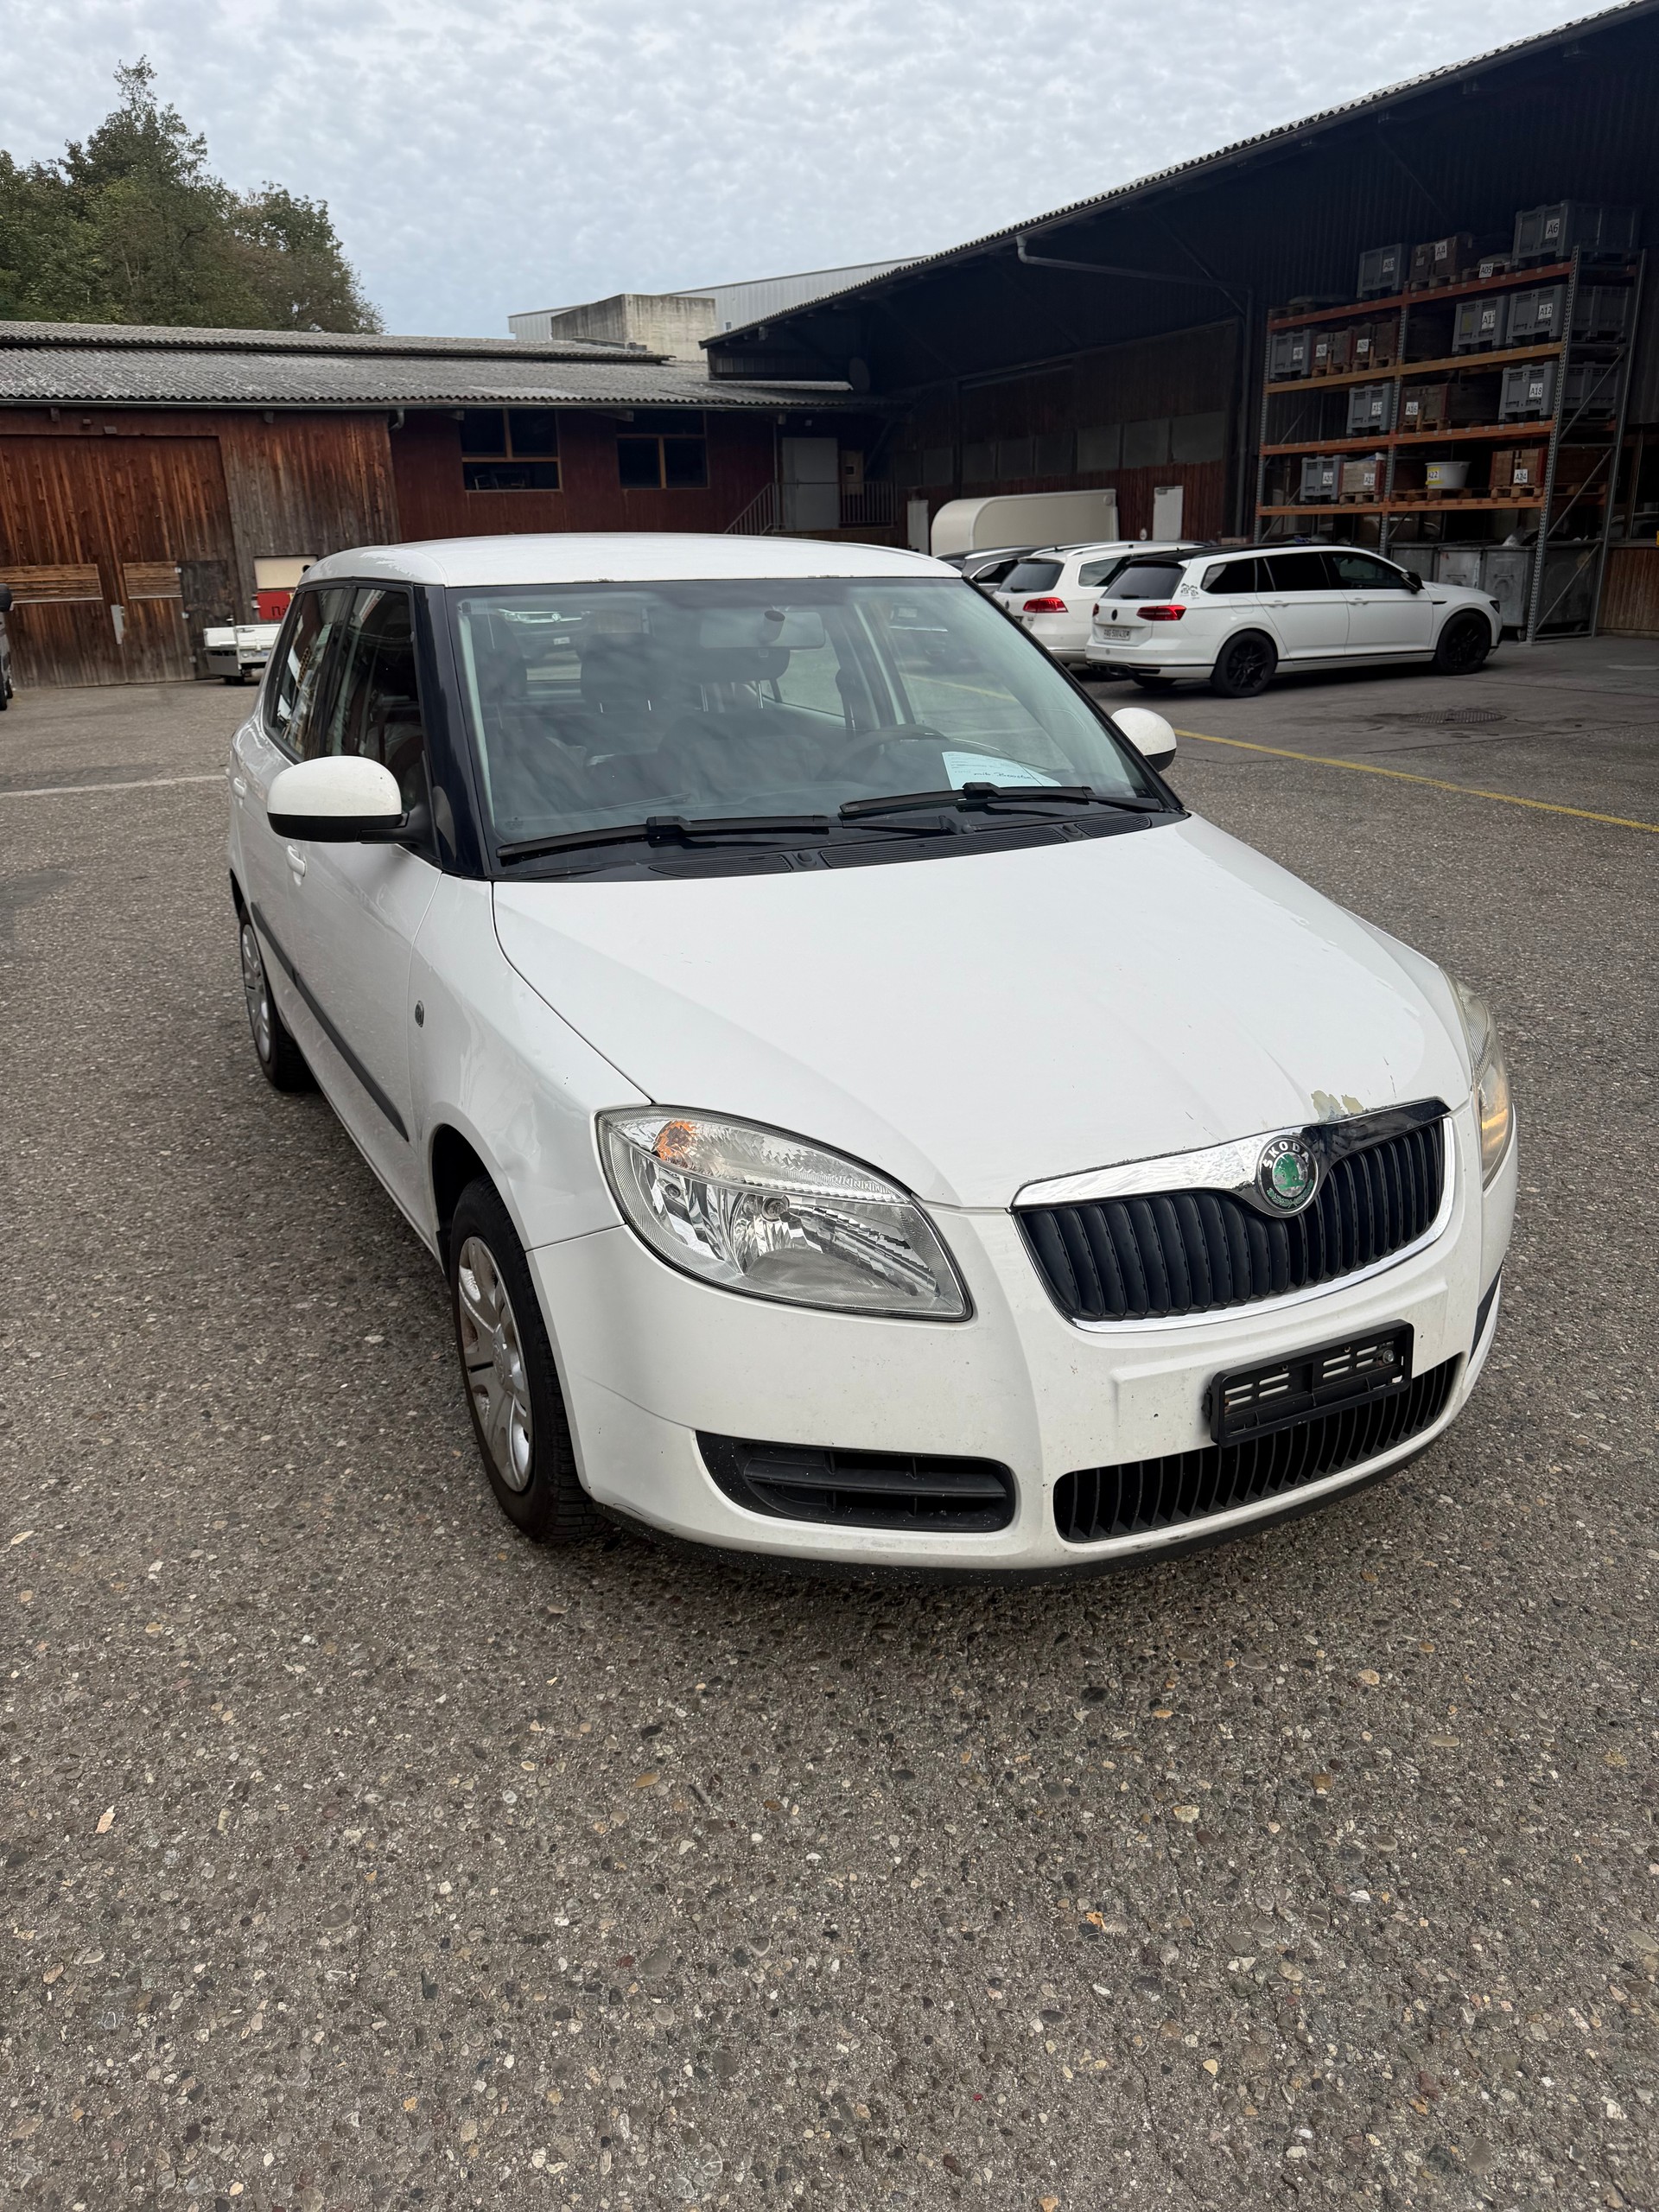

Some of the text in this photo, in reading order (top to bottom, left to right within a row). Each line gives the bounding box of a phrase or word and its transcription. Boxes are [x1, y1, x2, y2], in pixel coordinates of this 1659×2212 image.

[1547, 222, 1559, 235] A6
[1436, 245, 1446, 257] A4
[1480, 265, 1492, 275] A05
[1539, 306, 1552, 316] A12
[1483, 315, 1495, 325] A11
[1530, 386, 1542, 396] A18
[1406, 405, 1418, 414] A16
[1515, 473, 1527, 481] A24
